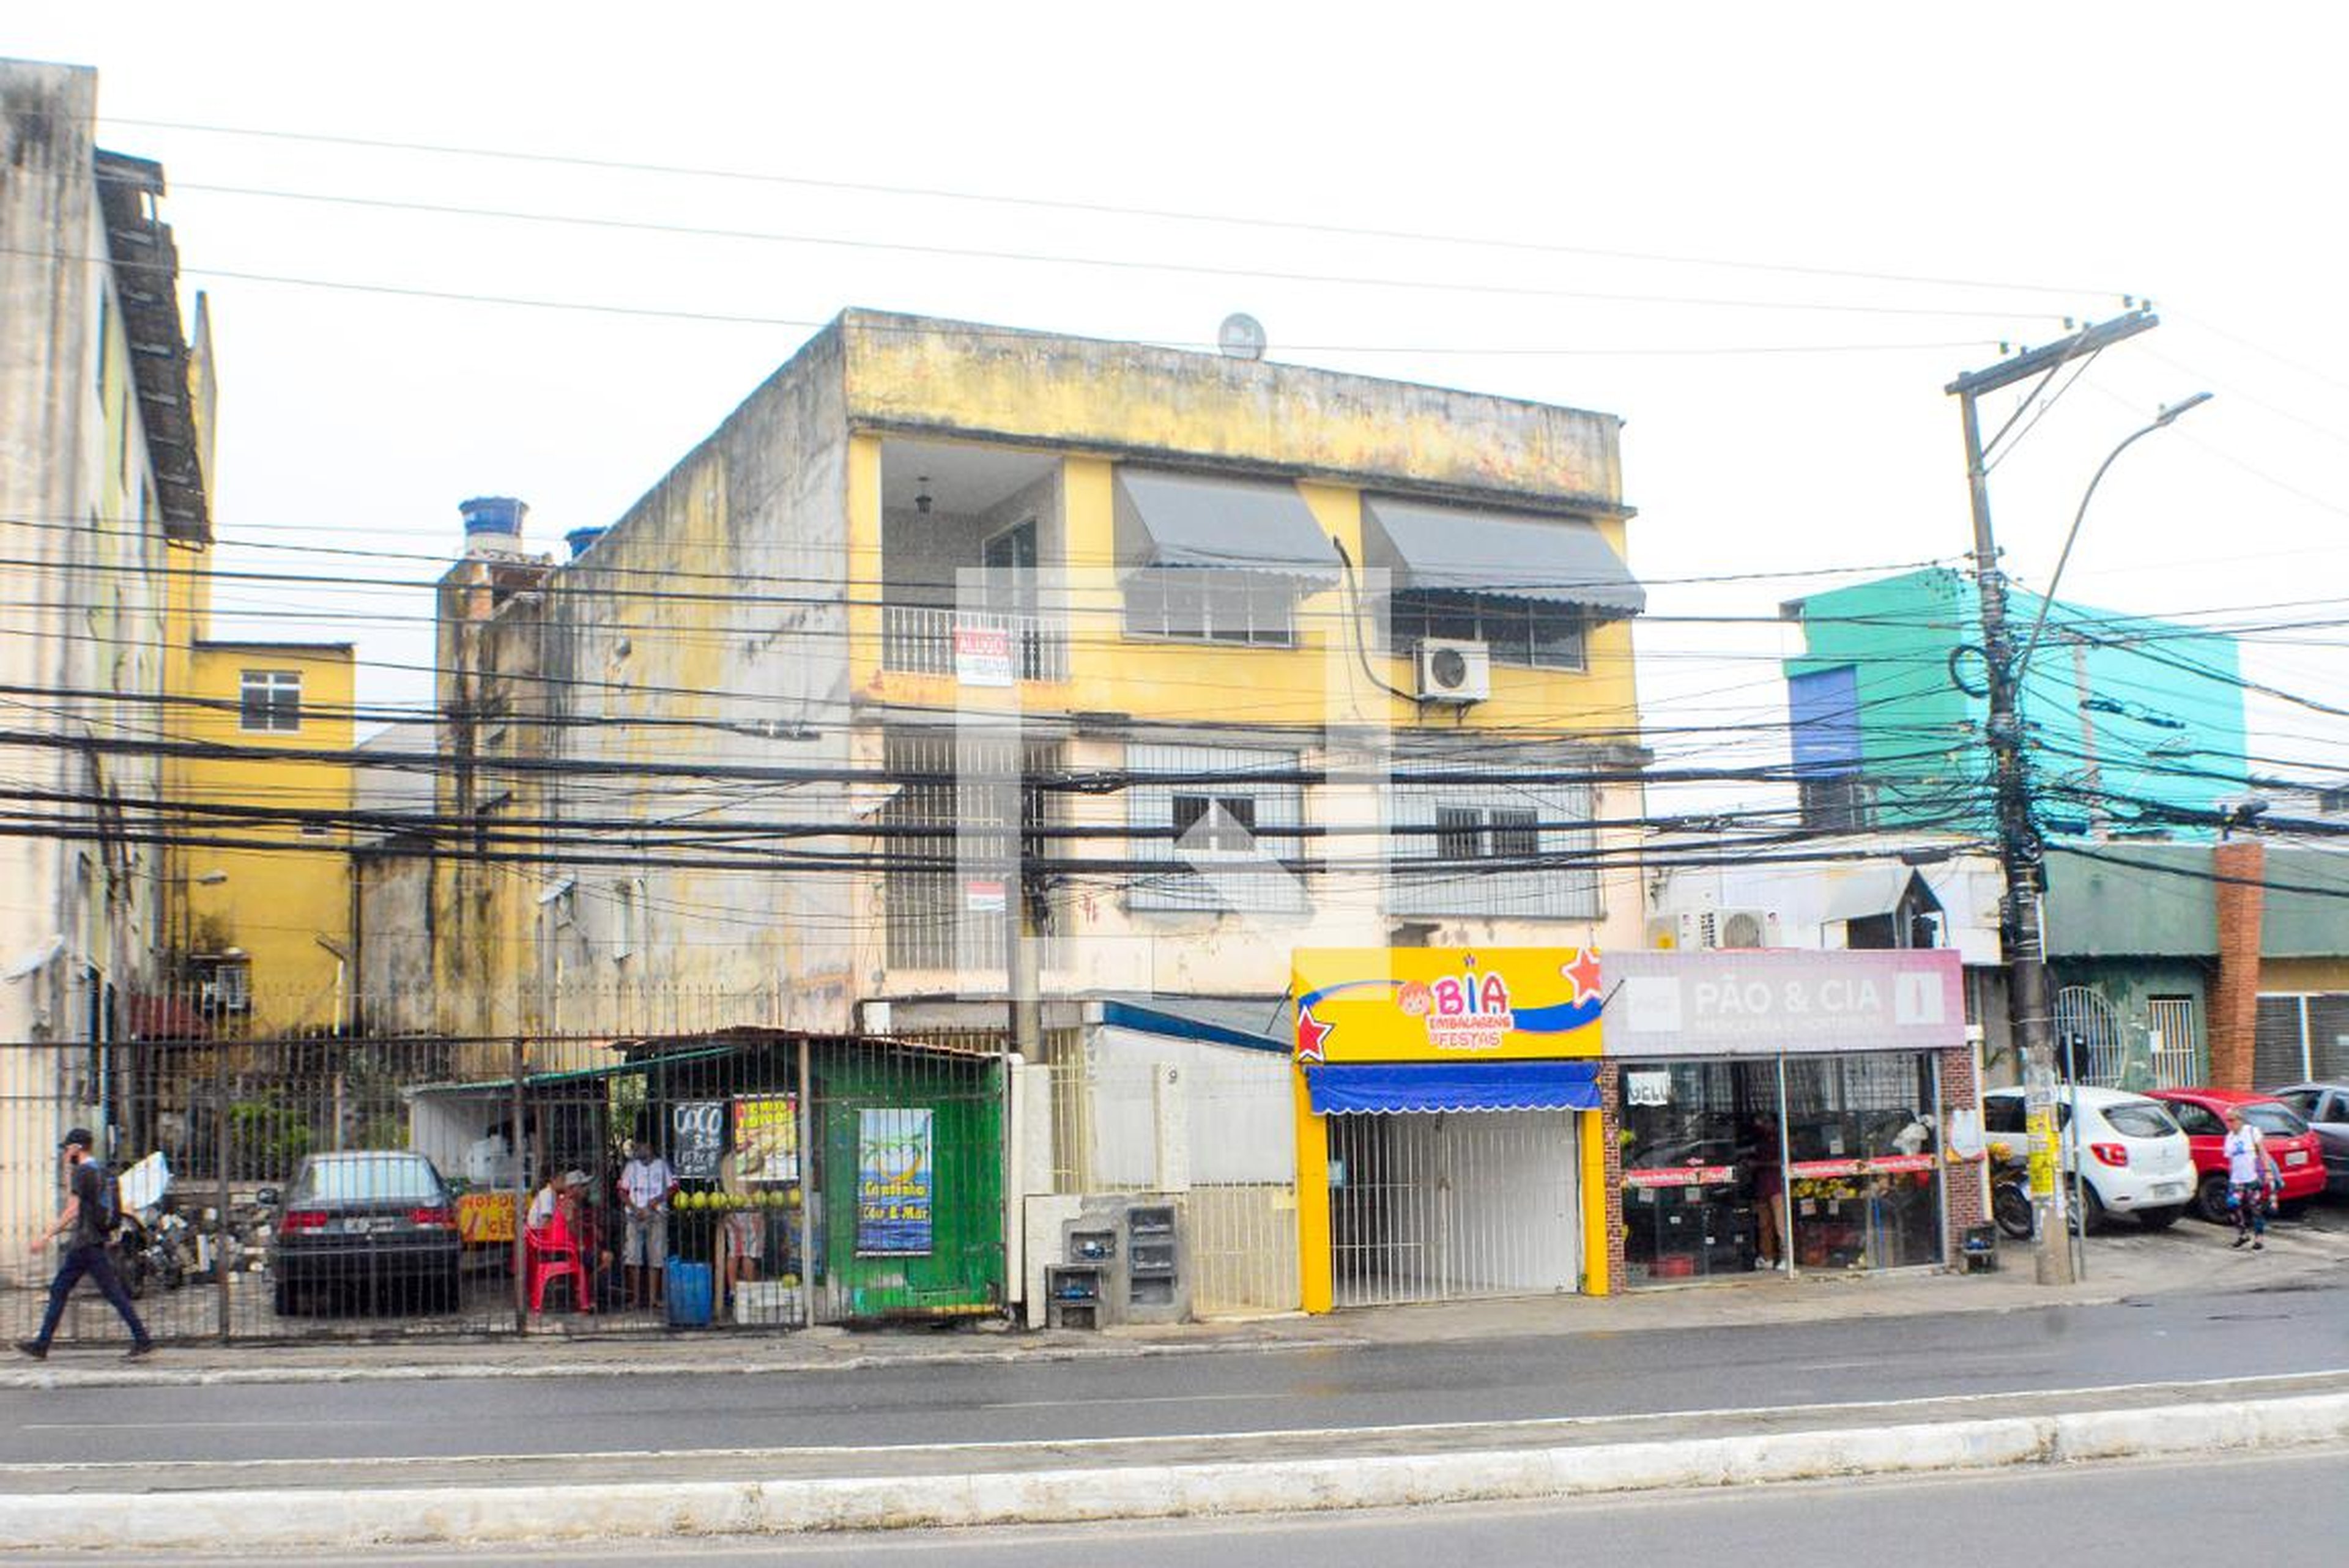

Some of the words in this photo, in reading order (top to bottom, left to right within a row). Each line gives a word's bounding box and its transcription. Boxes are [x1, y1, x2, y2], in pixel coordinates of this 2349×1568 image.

[1434, 975, 1507, 1015] BIA
[1695, 973, 1772, 1014] PÃO
[1784, 981, 1809, 1013] &
[1820, 979, 1880, 1012] CIA
[1439, 1032, 1501, 1048] FESTAS
[674, 1106, 723, 1133] COCO
